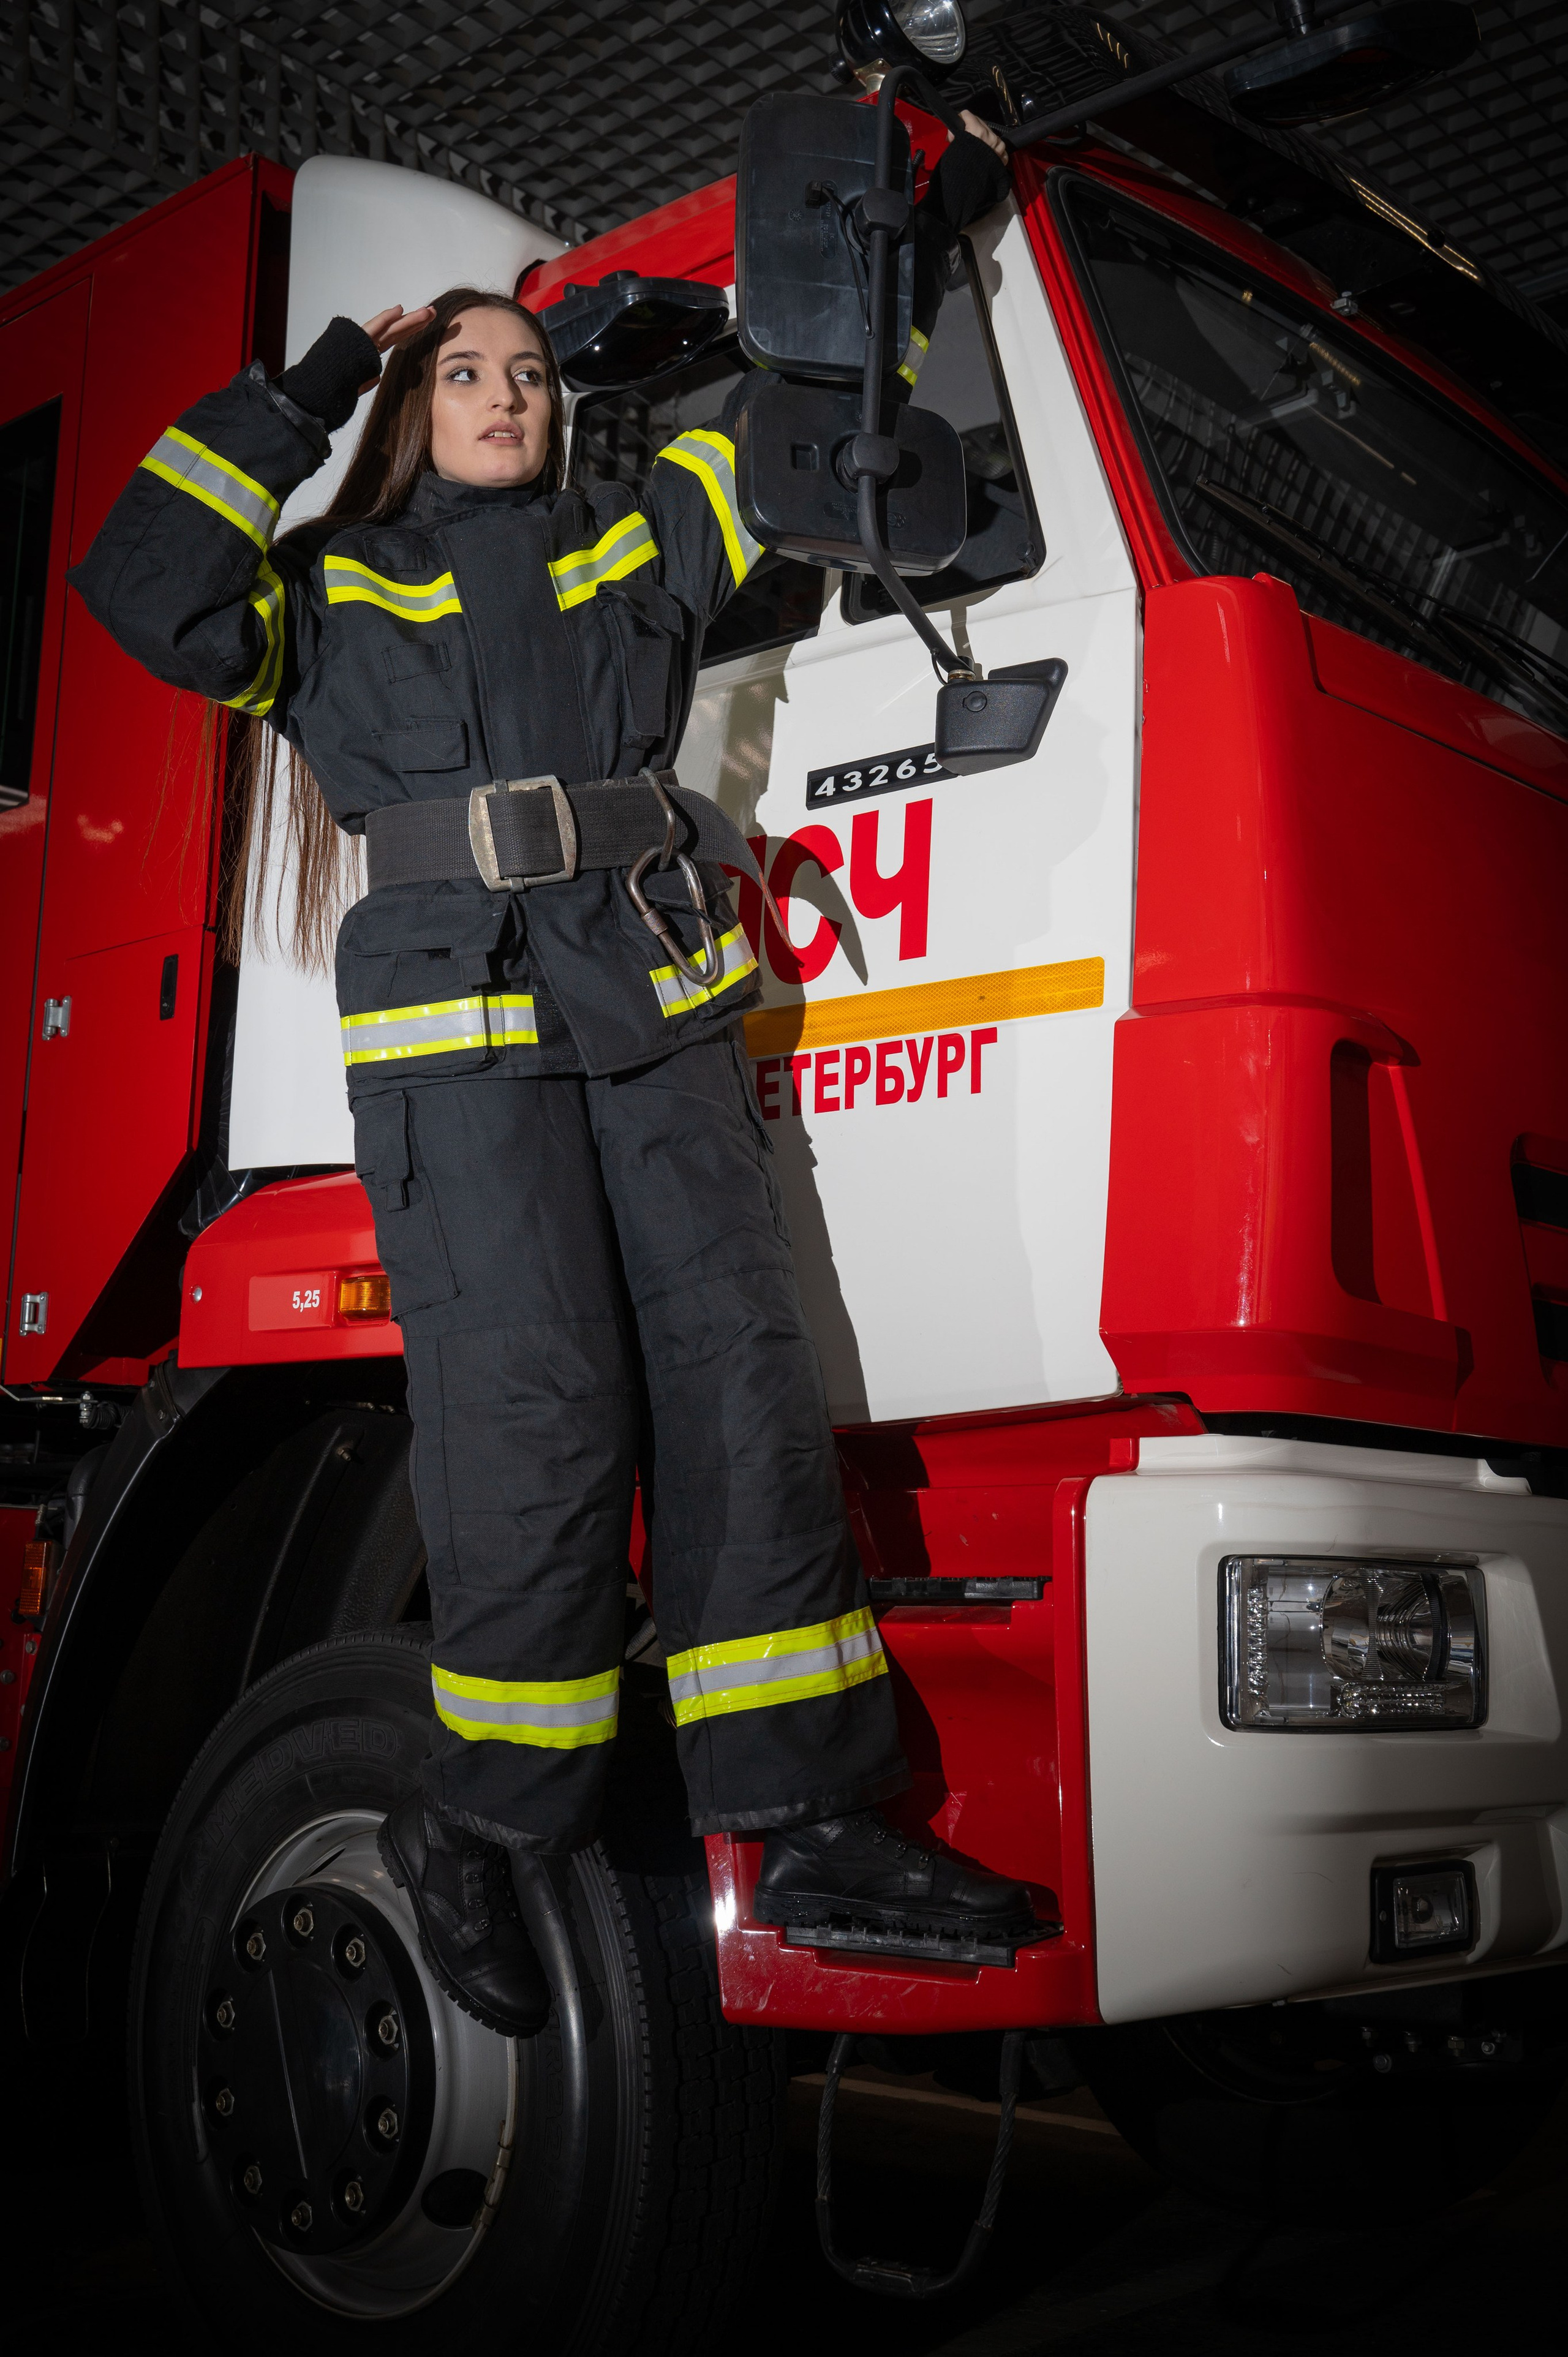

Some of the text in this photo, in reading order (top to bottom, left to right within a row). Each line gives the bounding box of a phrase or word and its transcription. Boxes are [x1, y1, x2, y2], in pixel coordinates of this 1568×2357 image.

[815, 753, 943, 796] 43265
[292, 1289, 320, 1312] 5,25
[203, 1717, 397, 1847] MEDVED
